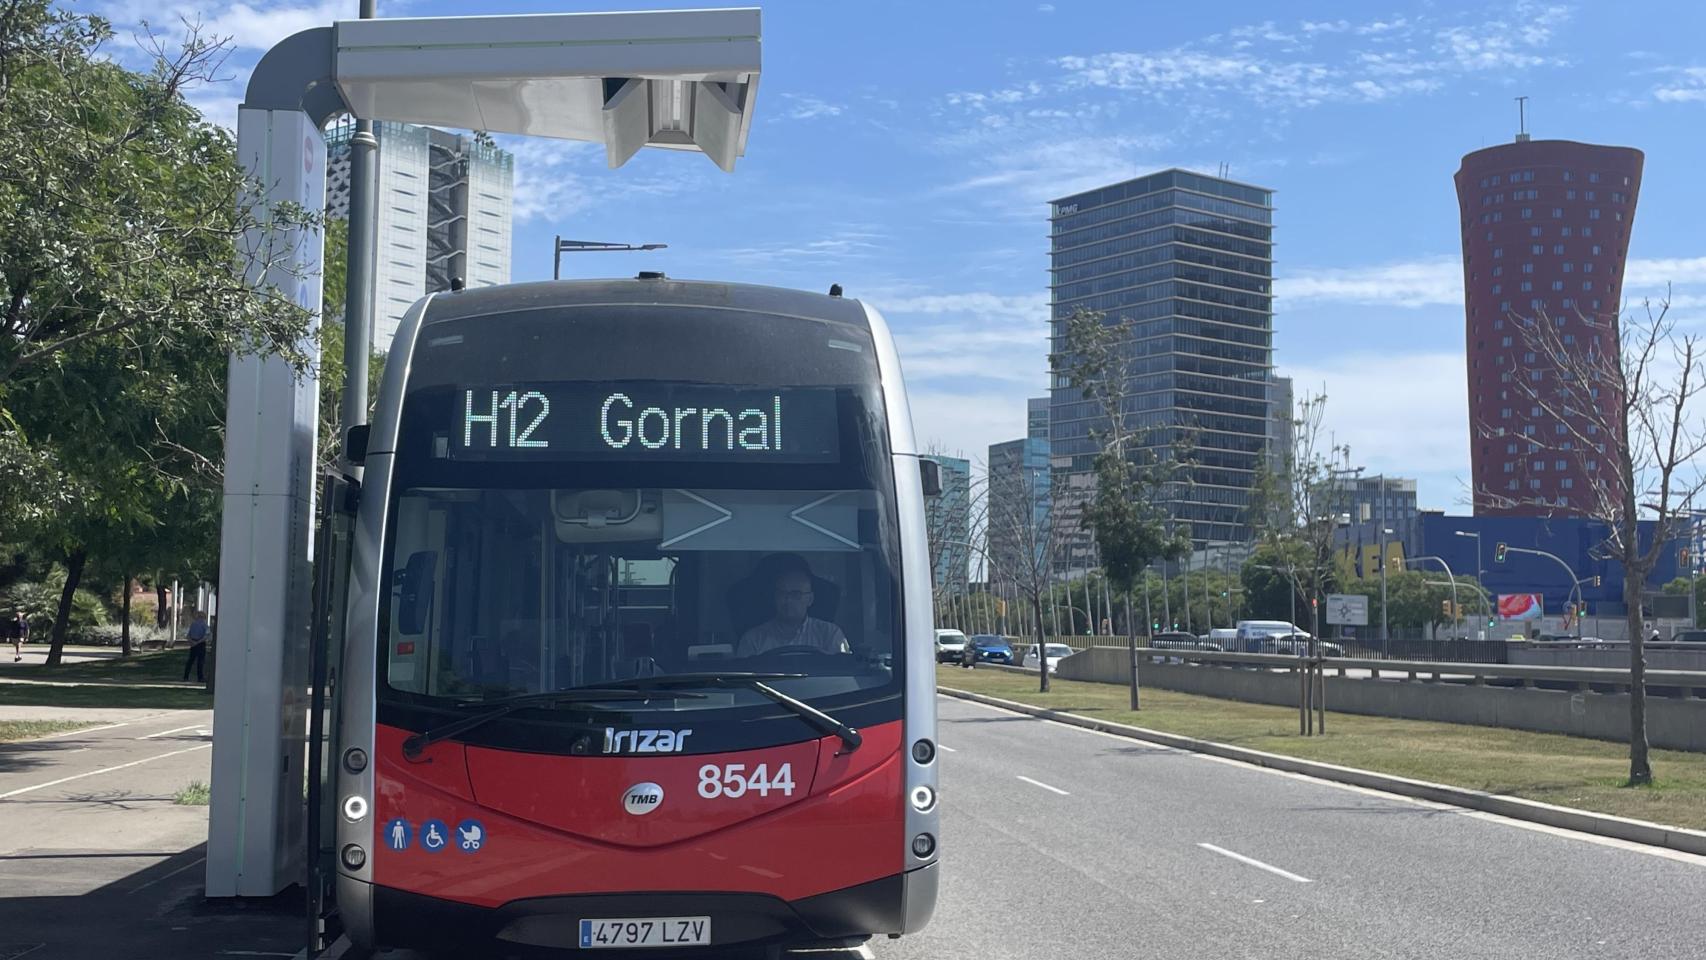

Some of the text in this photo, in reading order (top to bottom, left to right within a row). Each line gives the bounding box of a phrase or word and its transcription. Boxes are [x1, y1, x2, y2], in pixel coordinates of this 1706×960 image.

[464, 389, 782, 450] H12 Gornal
[602, 727, 692, 753] Irizar
[697, 763, 795, 798] 8544
[630, 794, 658, 804] TMB
[595, 922, 654, 945] 4797
[662, 921, 705, 943] LZV
